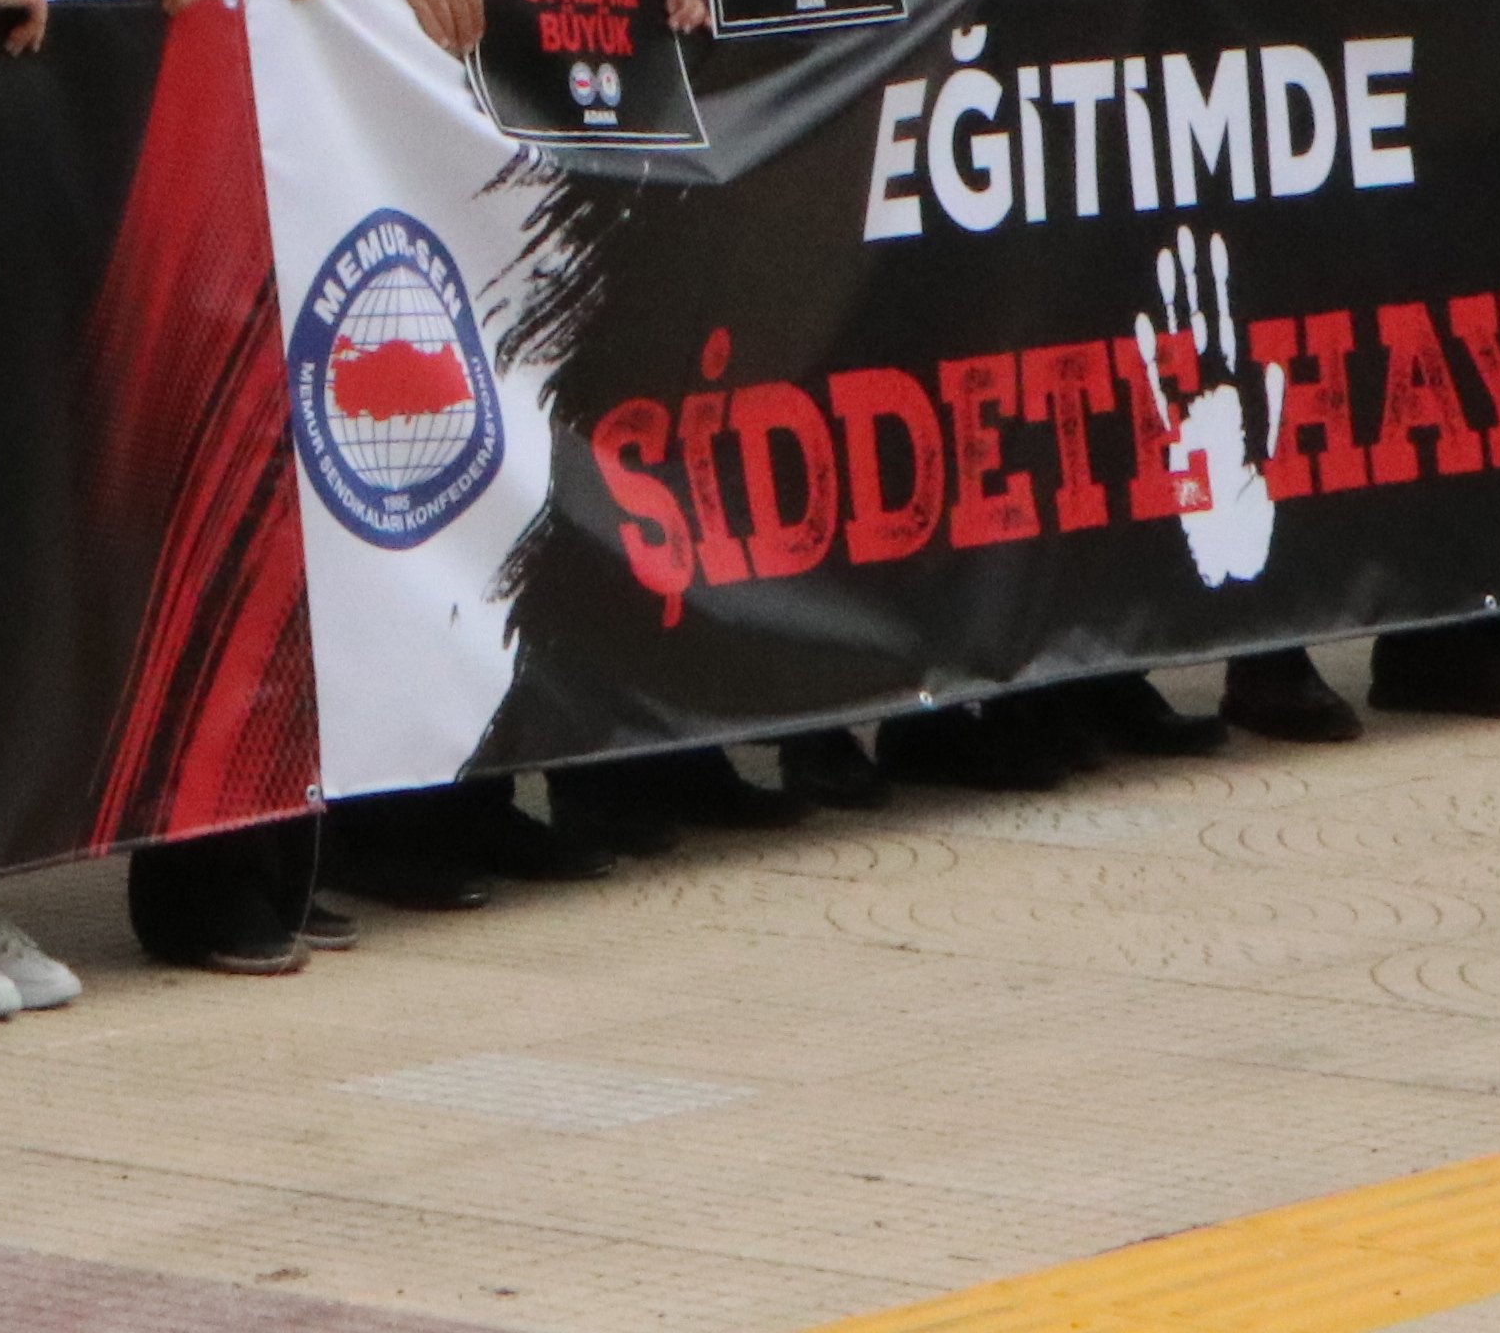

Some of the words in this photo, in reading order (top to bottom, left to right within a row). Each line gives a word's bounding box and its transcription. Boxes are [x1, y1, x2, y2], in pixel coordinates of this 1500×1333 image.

[539, 1, 635, 56] BÜYÜK
[863, 24, 1416, 242] EĞİTİMDE
[313, 222, 463, 326] MEMUR-SEN
[300, 361, 326, 455] MEMUR
[591, 328, 1211, 628] ŞİDDETE
